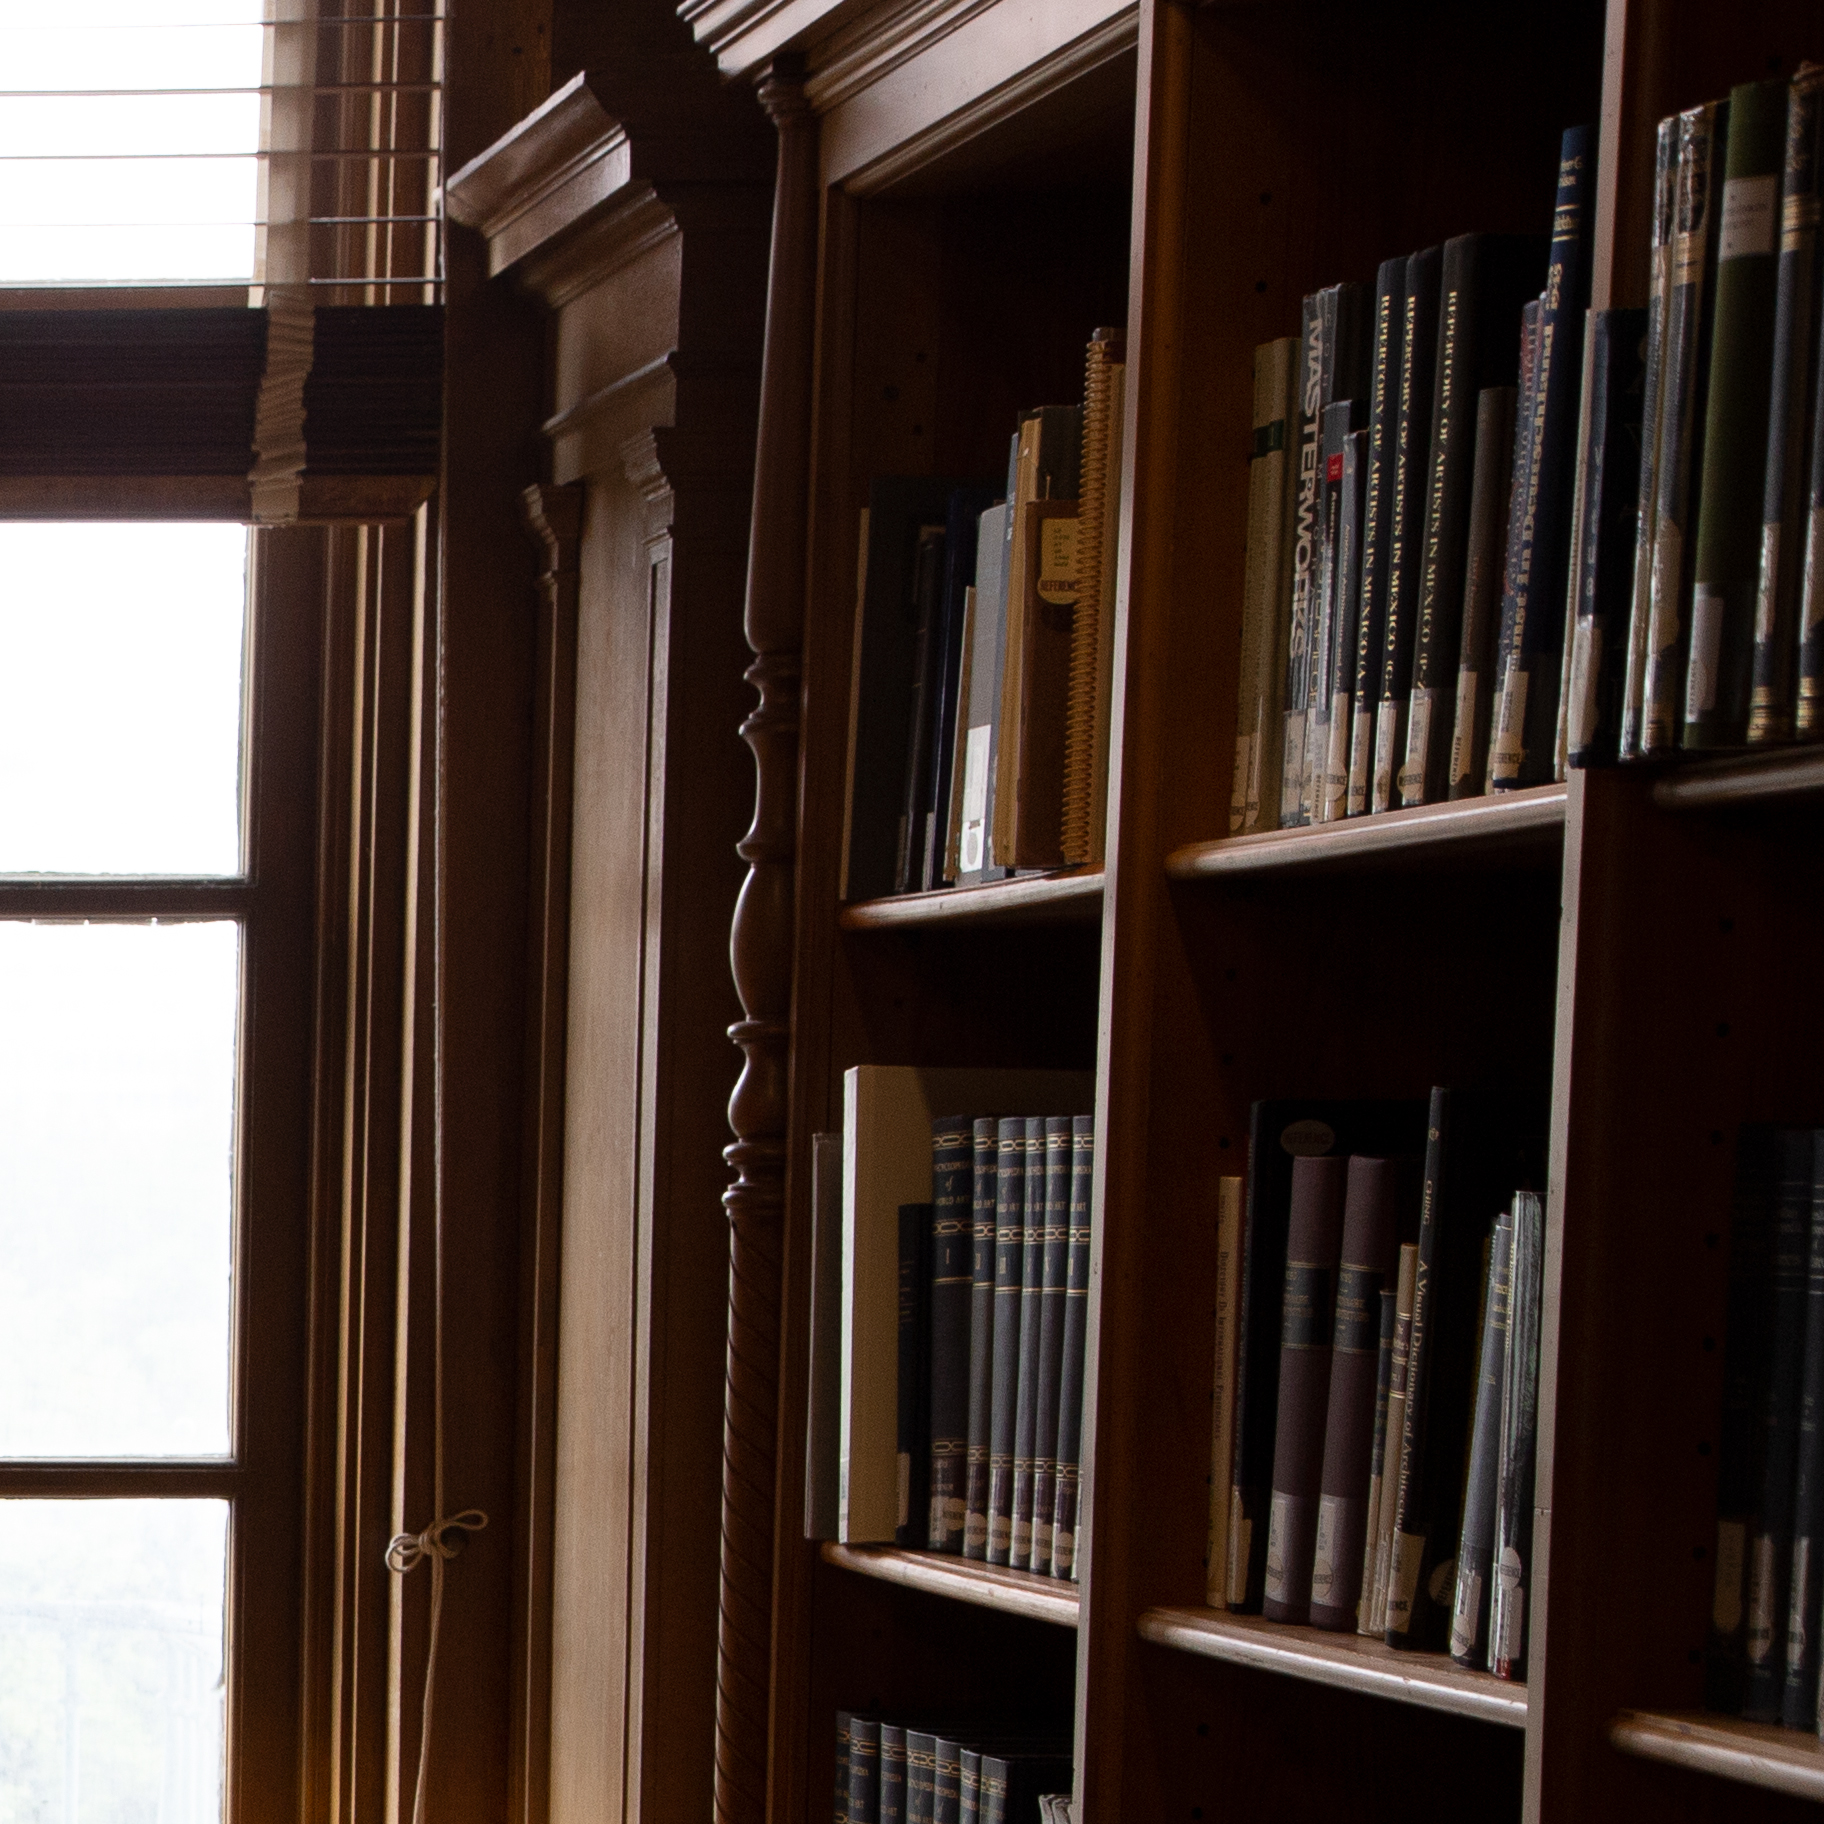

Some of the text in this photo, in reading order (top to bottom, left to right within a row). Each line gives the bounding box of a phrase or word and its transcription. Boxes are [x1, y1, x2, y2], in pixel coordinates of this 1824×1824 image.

[1373, 294, 1391, 416] REPERTORY
[1400, 294, 1417, 413] REPERTORY
[1440, 289, 1459, 413] REPERTORY
[1370, 423, 1383, 449] OF
[1398, 421, 1409, 447] OF
[1436, 418, 1450, 446] OF
[1289, 318, 1324, 660] MASTERWORKS
[1365, 459, 1381, 541] ARTISTS
[1392, 453, 1408, 536] ARTISTS
[1429, 451, 1448, 531] ARTISTS
[1363, 547, 1375, 570] IN
[1391, 541, 1403, 564] IN
[1427, 536, 1439, 557] IN
[1334, 523, 1351, 687] American Architecture and Art
[1357, 575, 1373, 654] MEXICO
[1385, 569, 1401, 651] MEXICO
[1419, 562, 1438, 643] MEXICO
[1511, 594, 1527, 657] unst
[1420, 1179, 1434, 1225] CHING
[1393, 1259, 1429, 1533] A Visual Dictionary of Architectur
